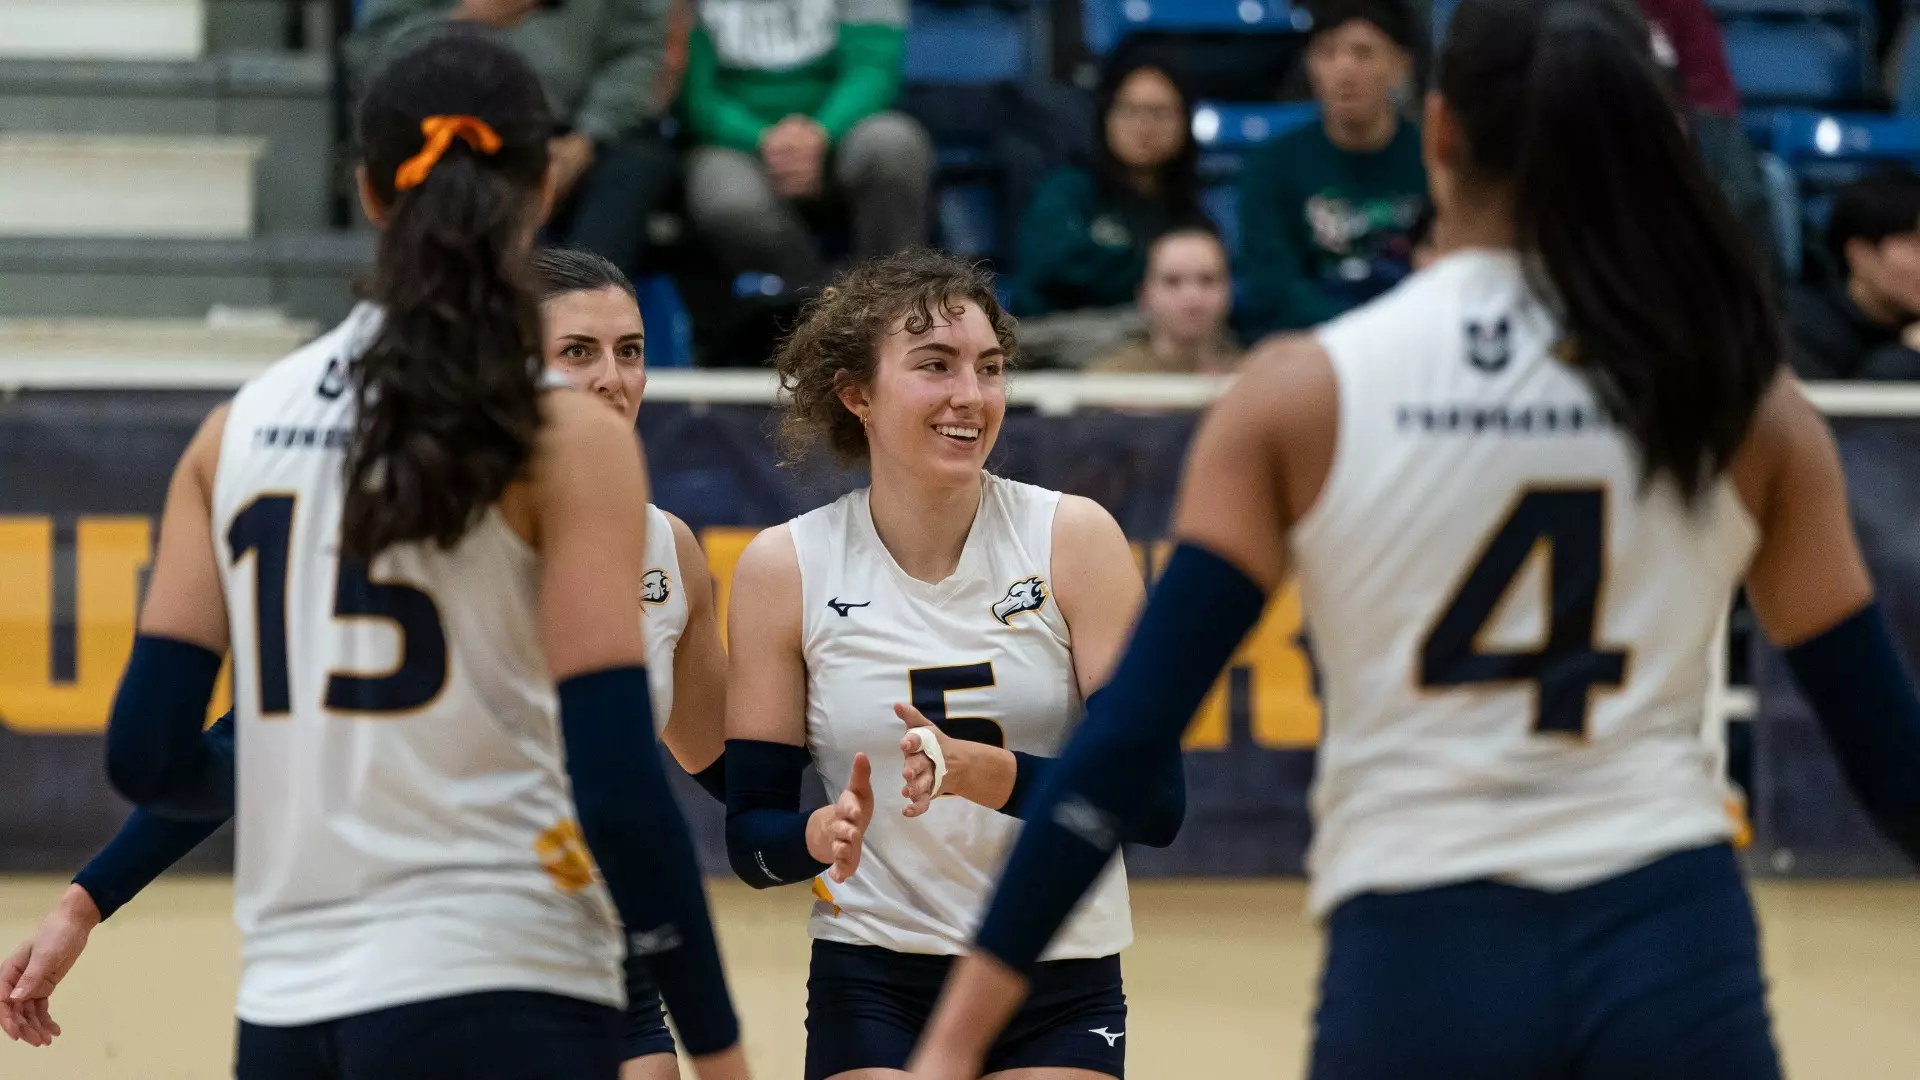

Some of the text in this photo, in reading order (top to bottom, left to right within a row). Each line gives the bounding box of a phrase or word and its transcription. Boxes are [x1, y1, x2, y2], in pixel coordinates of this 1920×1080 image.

[226, 492, 451, 715] 15
[1413, 480, 1632, 740] 4
[907, 660, 1005, 796] 5
